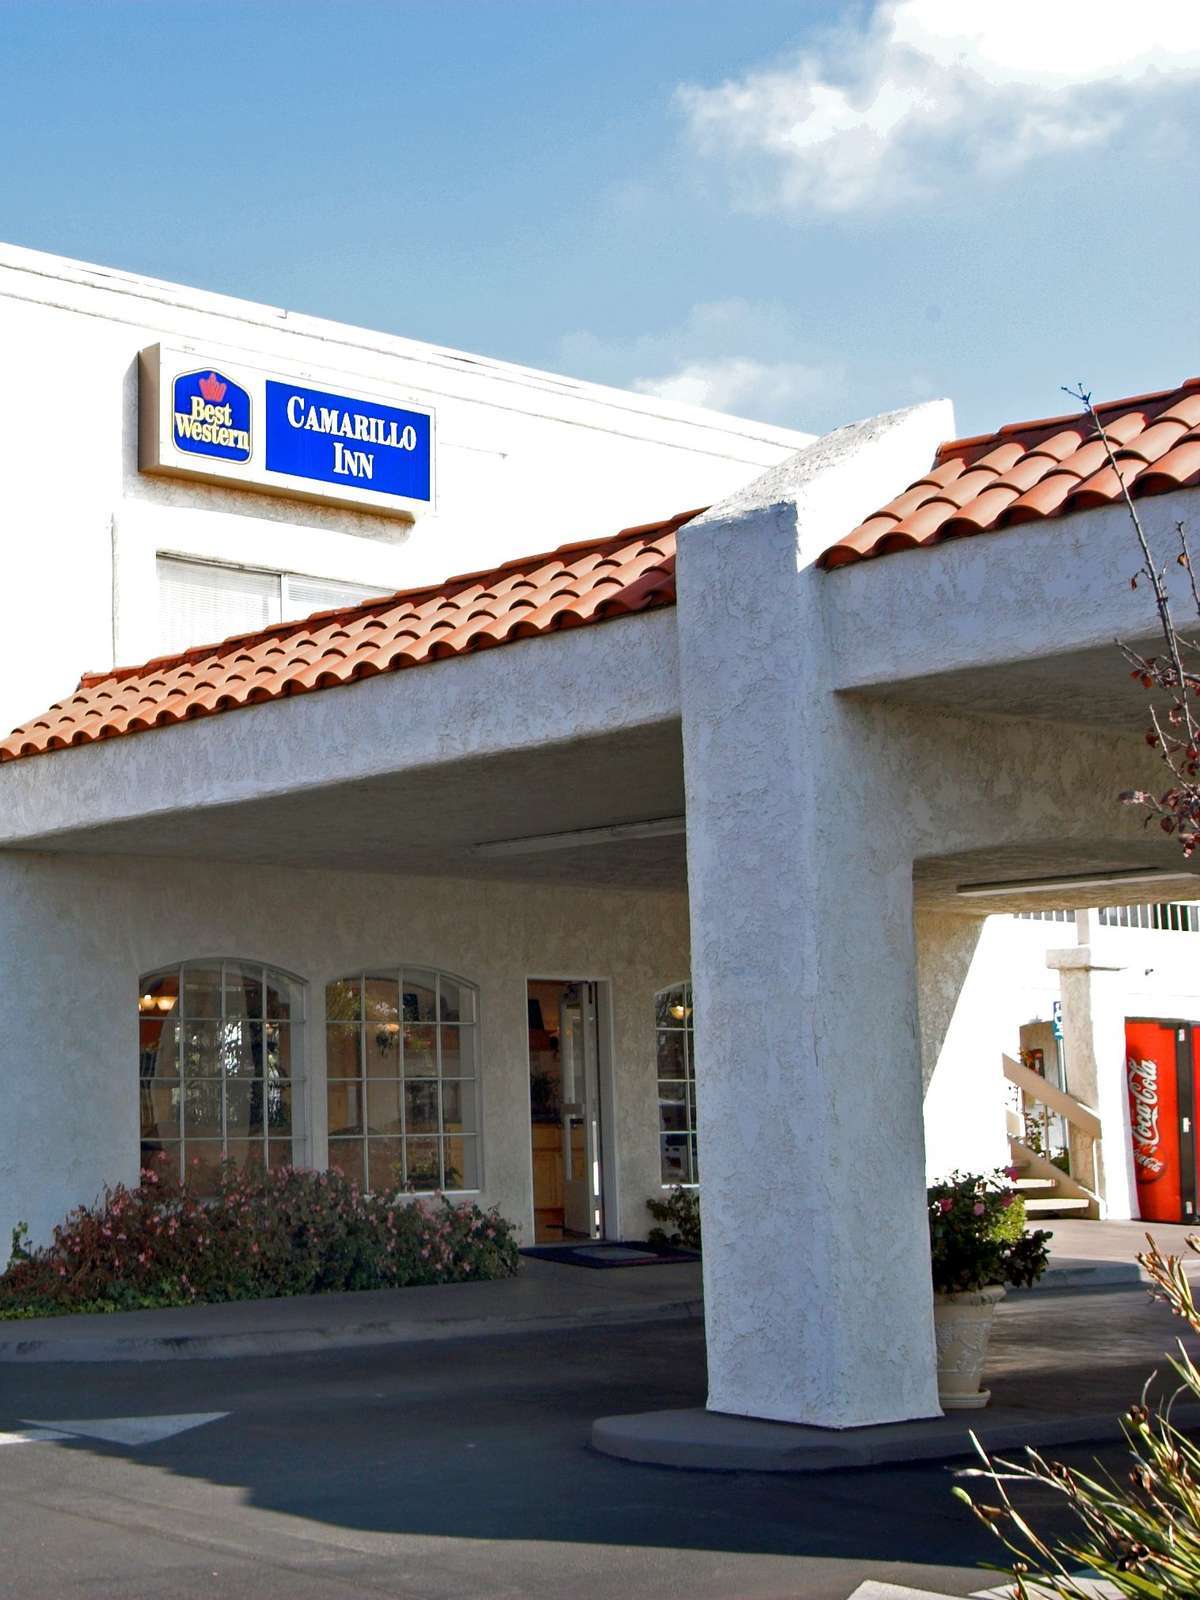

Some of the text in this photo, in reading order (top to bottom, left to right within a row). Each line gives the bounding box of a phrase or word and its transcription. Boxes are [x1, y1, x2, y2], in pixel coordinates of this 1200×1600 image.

[190, 395, 232, 427] Best
[287, 396, 417, 451] CAMARILLO
[174, 412, 249, 451] Western
[334, 442, 374, 480] INN
